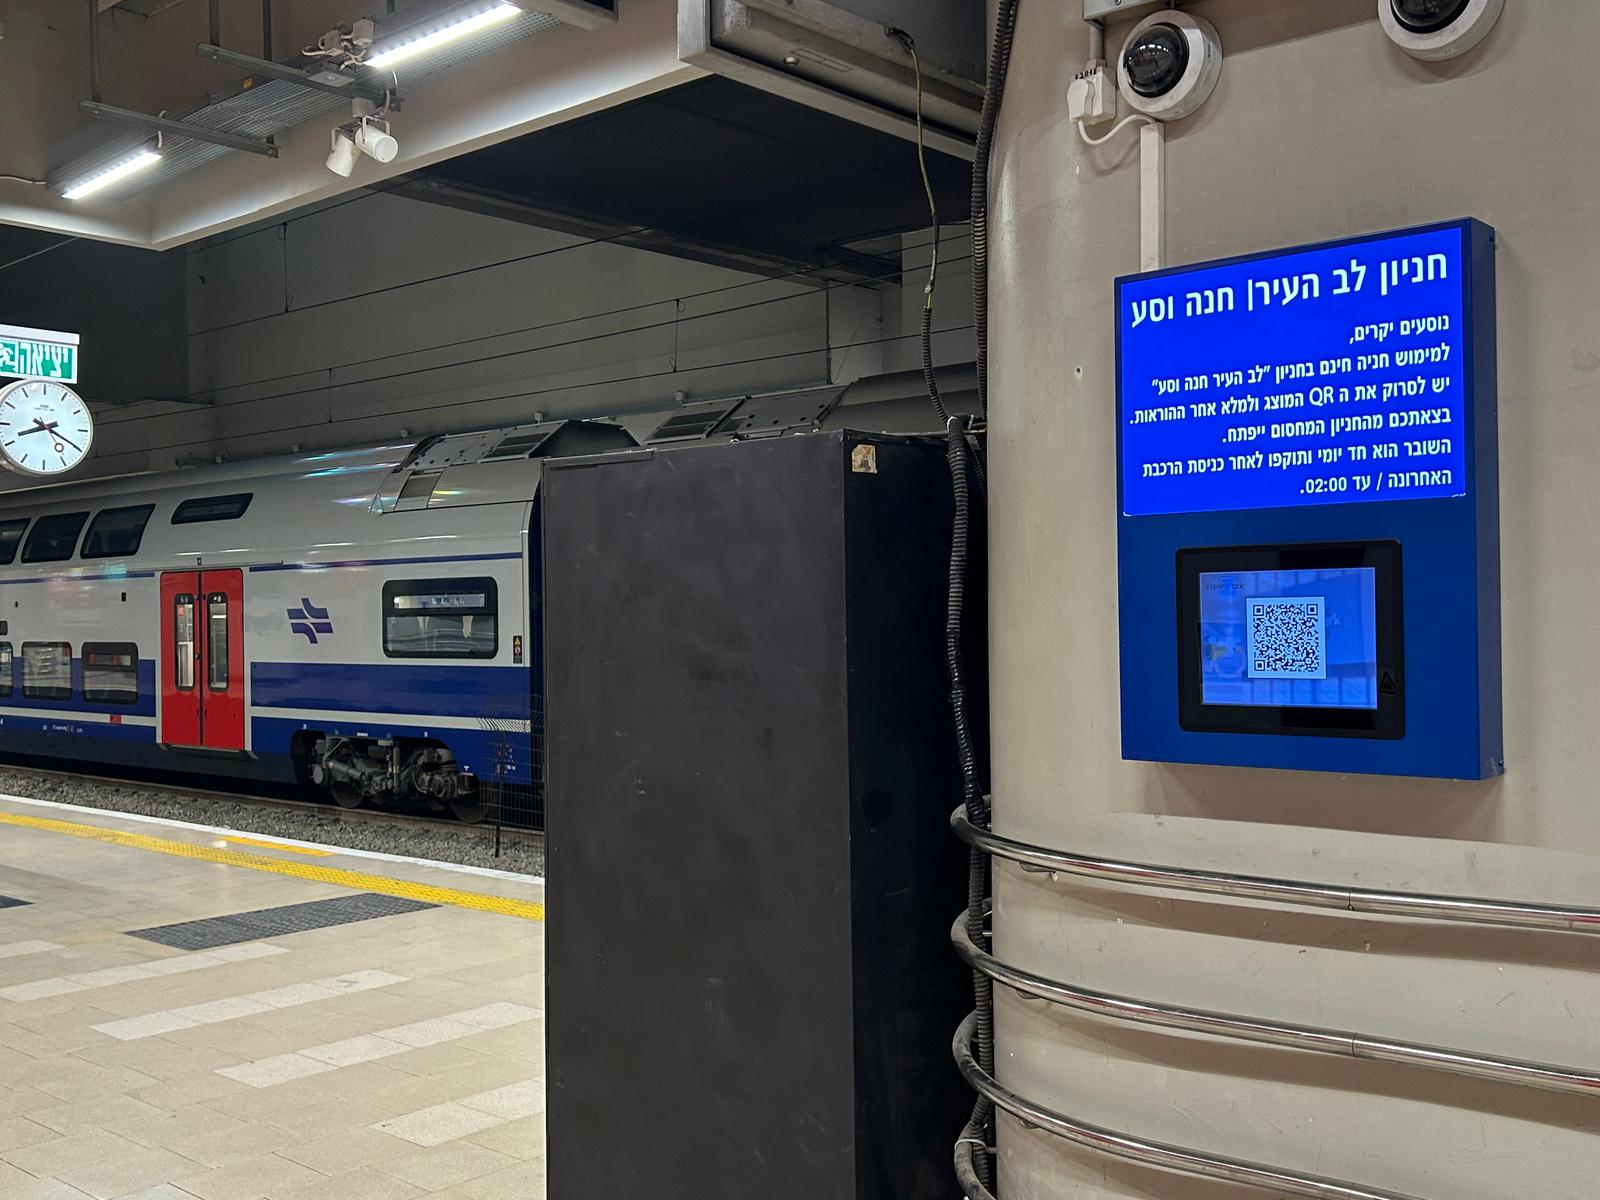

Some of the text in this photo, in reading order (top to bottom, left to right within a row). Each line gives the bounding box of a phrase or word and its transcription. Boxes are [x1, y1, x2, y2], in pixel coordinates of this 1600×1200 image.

[1332, 258, 1367, 295] לב
[1380, 253, 1447, 296] חניון
[1131, 295, 1174, 328] וסע
[1185, 286, 1235, 316] חנה
[1349, 314, 1450, 344] נוסעים יקרים,
[19, 342, 69, 378] יציאה
[1319, 357, 1352, 375] חינם
[1356, 352, 1390, 370] חניה
[1395, 341, 1451, 366] למימוש
[1184, 374, 1209, 391] חנה
[1212, 370, 1243, 387] העיר
[1275, 362, 1316, 384] בחניון
[1129, 375, 1451, 424] יש לסרוק את ה QR המוצג ולמלא אחר ההוראות.
[1222, 407, 1452, 443] בצאתכם מהחניון המחסום ייפתח.
[1142, 438, 1452, 477] השובר הוא חד יומי ותוקפו לאחר כניסת הרכבת
[1299, 469, 1452, 493] האחרונה / עד 02:00.
